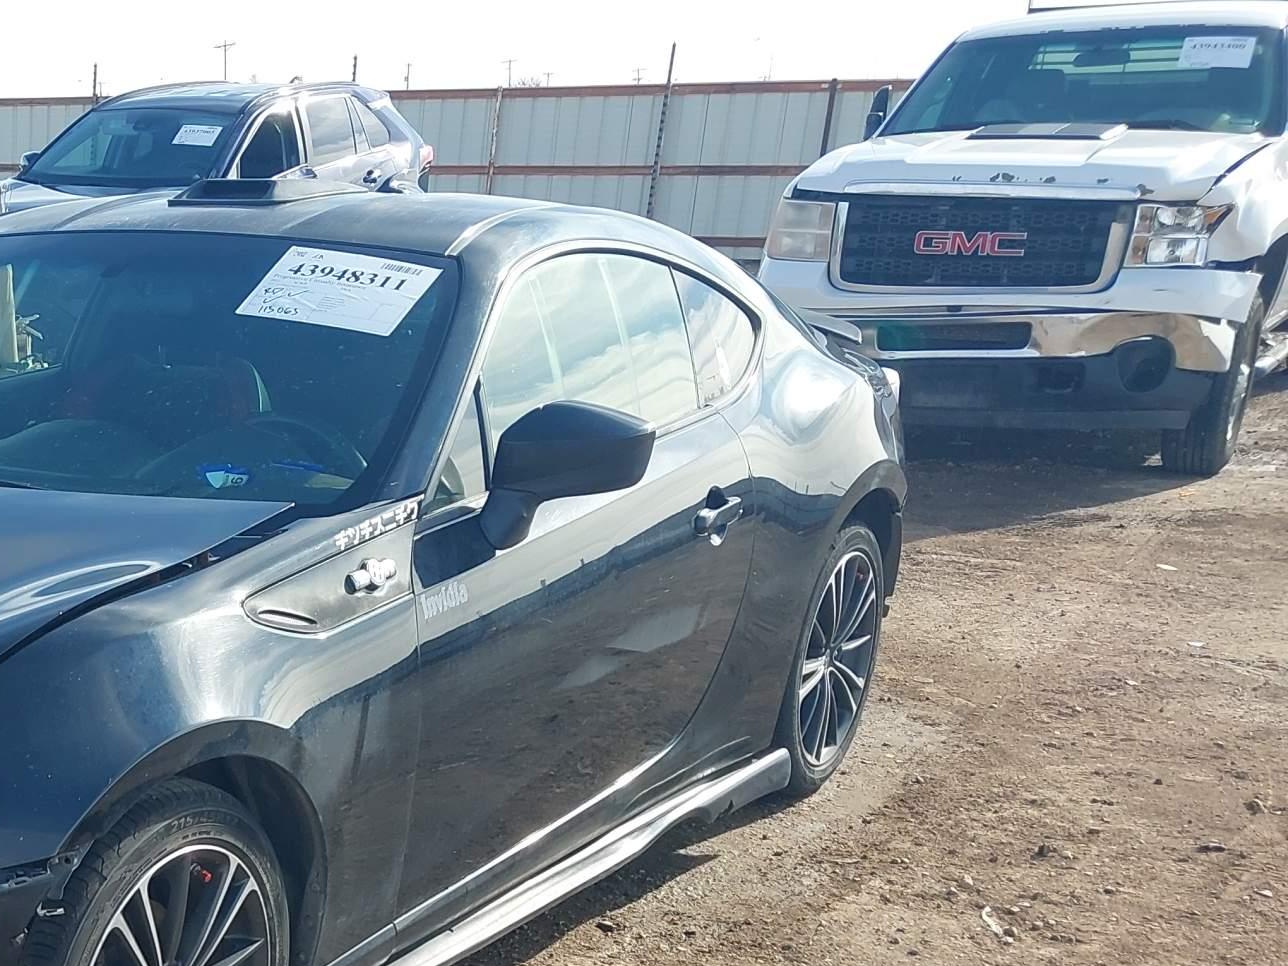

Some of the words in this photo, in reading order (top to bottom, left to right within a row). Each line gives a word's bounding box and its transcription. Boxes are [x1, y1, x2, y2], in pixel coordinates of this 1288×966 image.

[913, 230, 1027, 257] GMC
[288, 262, 409, 291] 43948311
[419, 581, 469, 620] Invidia
